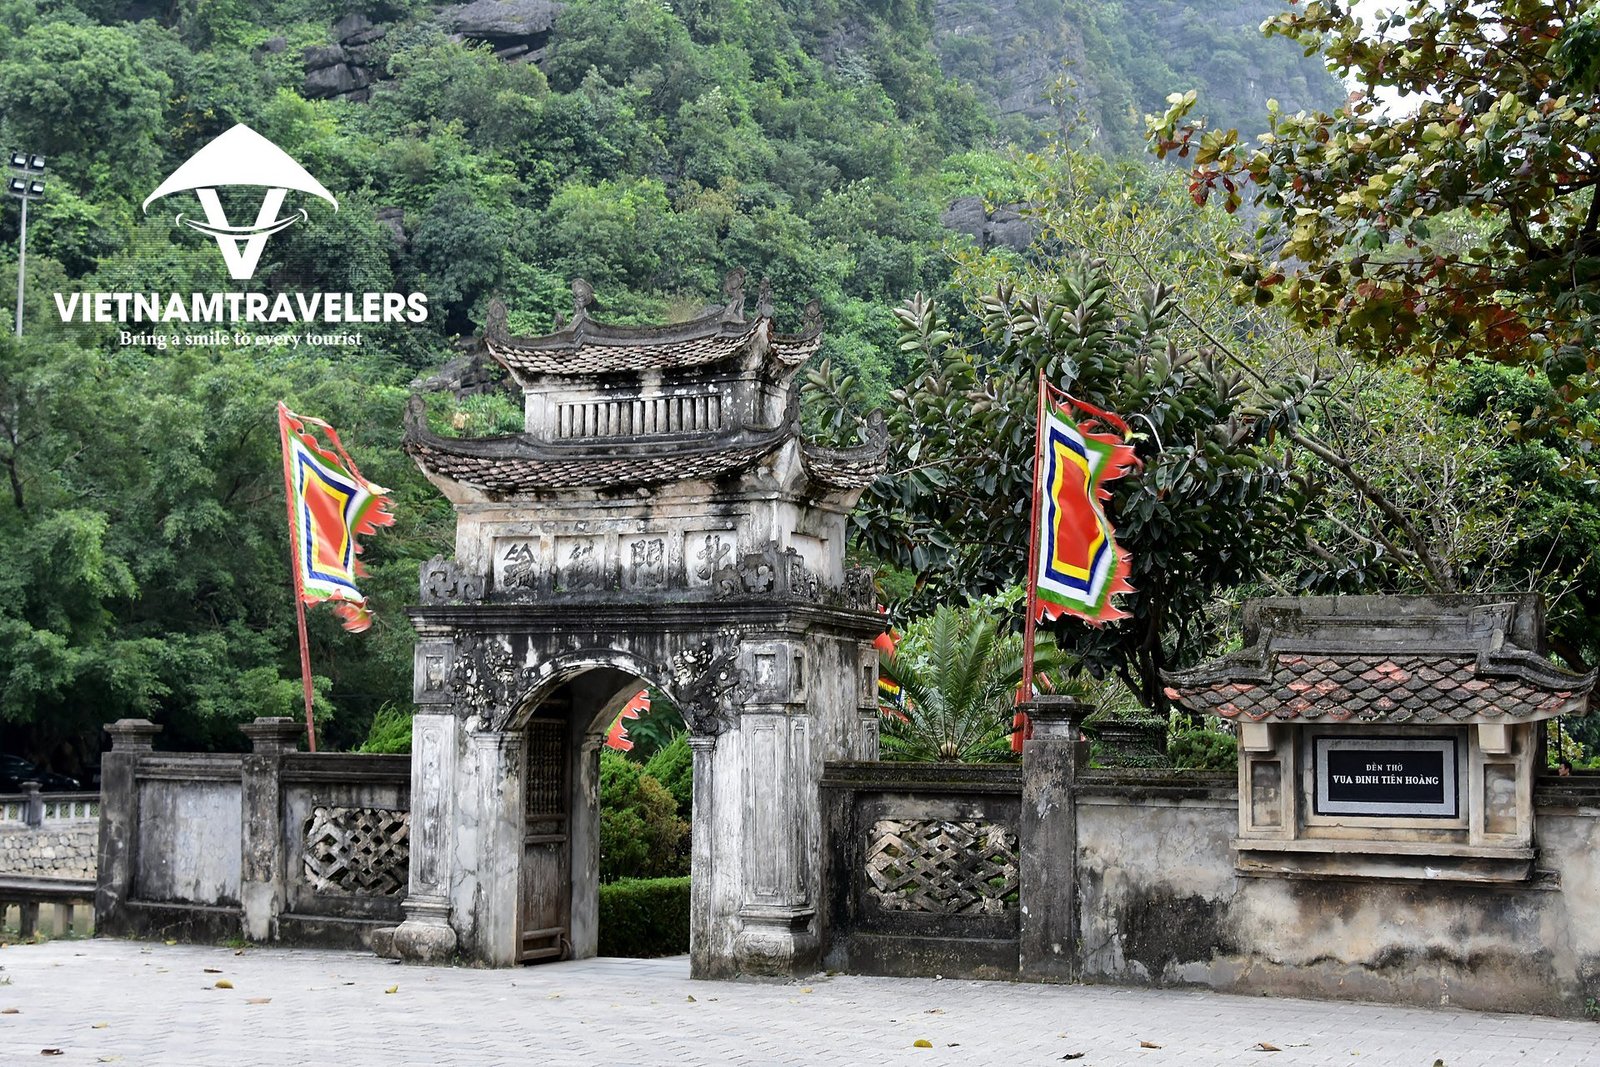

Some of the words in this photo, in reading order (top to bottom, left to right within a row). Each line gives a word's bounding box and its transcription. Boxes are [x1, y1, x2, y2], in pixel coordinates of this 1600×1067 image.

[1332, 775, 1353, 784] VUA
[1355, 775, 1379, 785] ĐINH
[1405, 773, 1439, 785] HOÀNG
